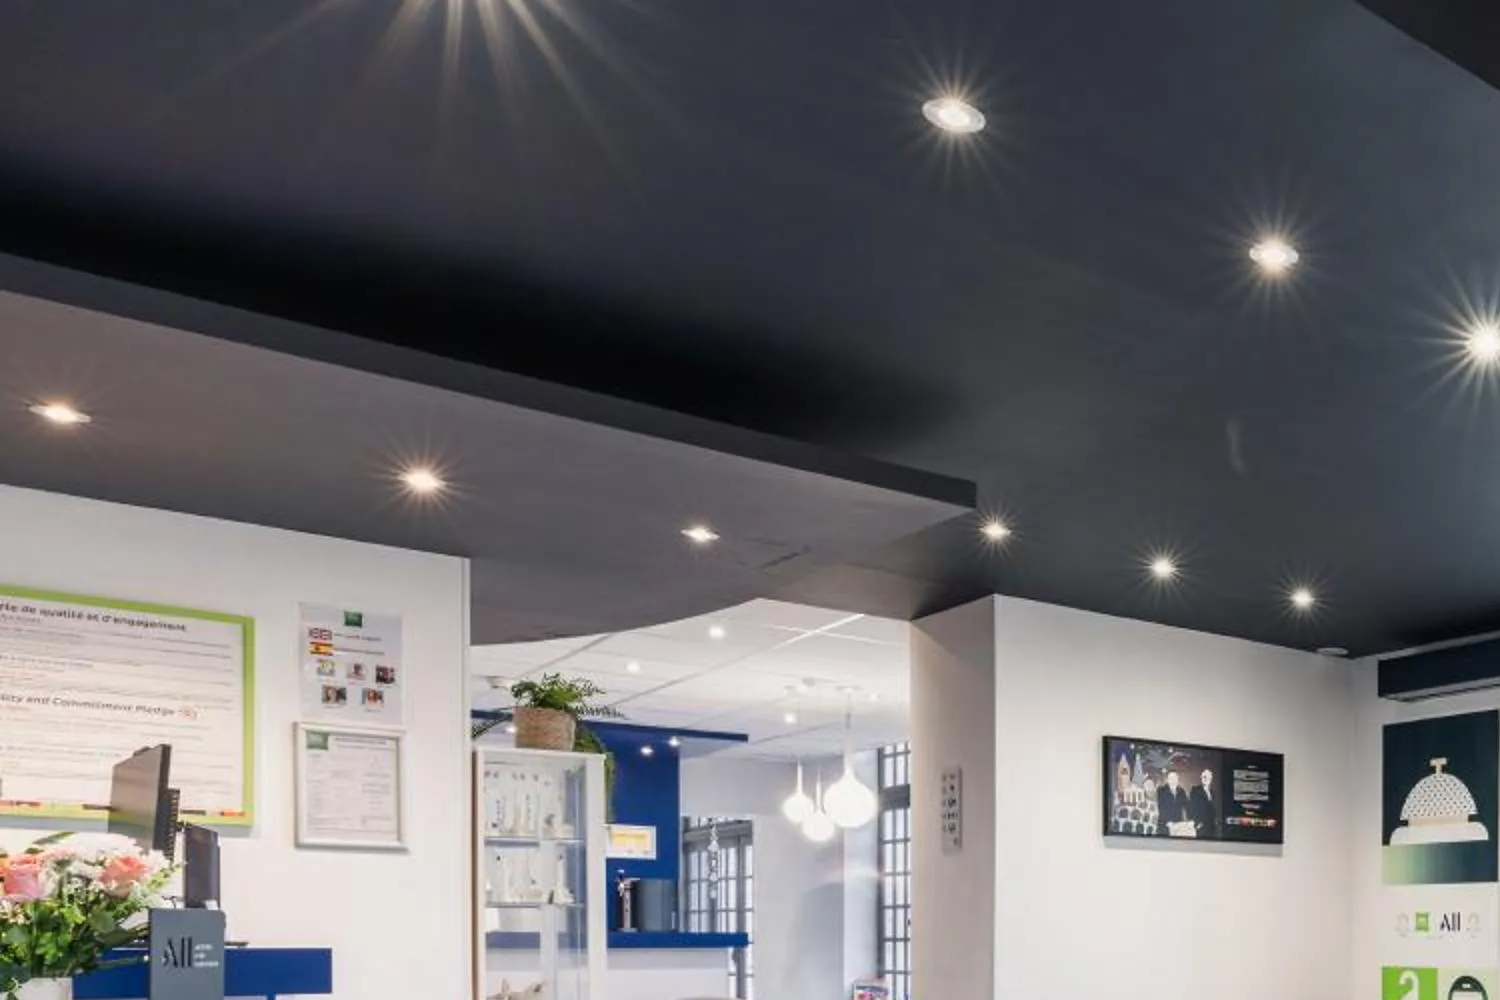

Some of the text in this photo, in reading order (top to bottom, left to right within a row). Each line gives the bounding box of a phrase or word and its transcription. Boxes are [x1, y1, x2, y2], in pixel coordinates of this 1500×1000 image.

[27, 695, 49, 705] and
[52, 696, 133, 712] Commitment
[136, 704, 175, 717] Pledge
